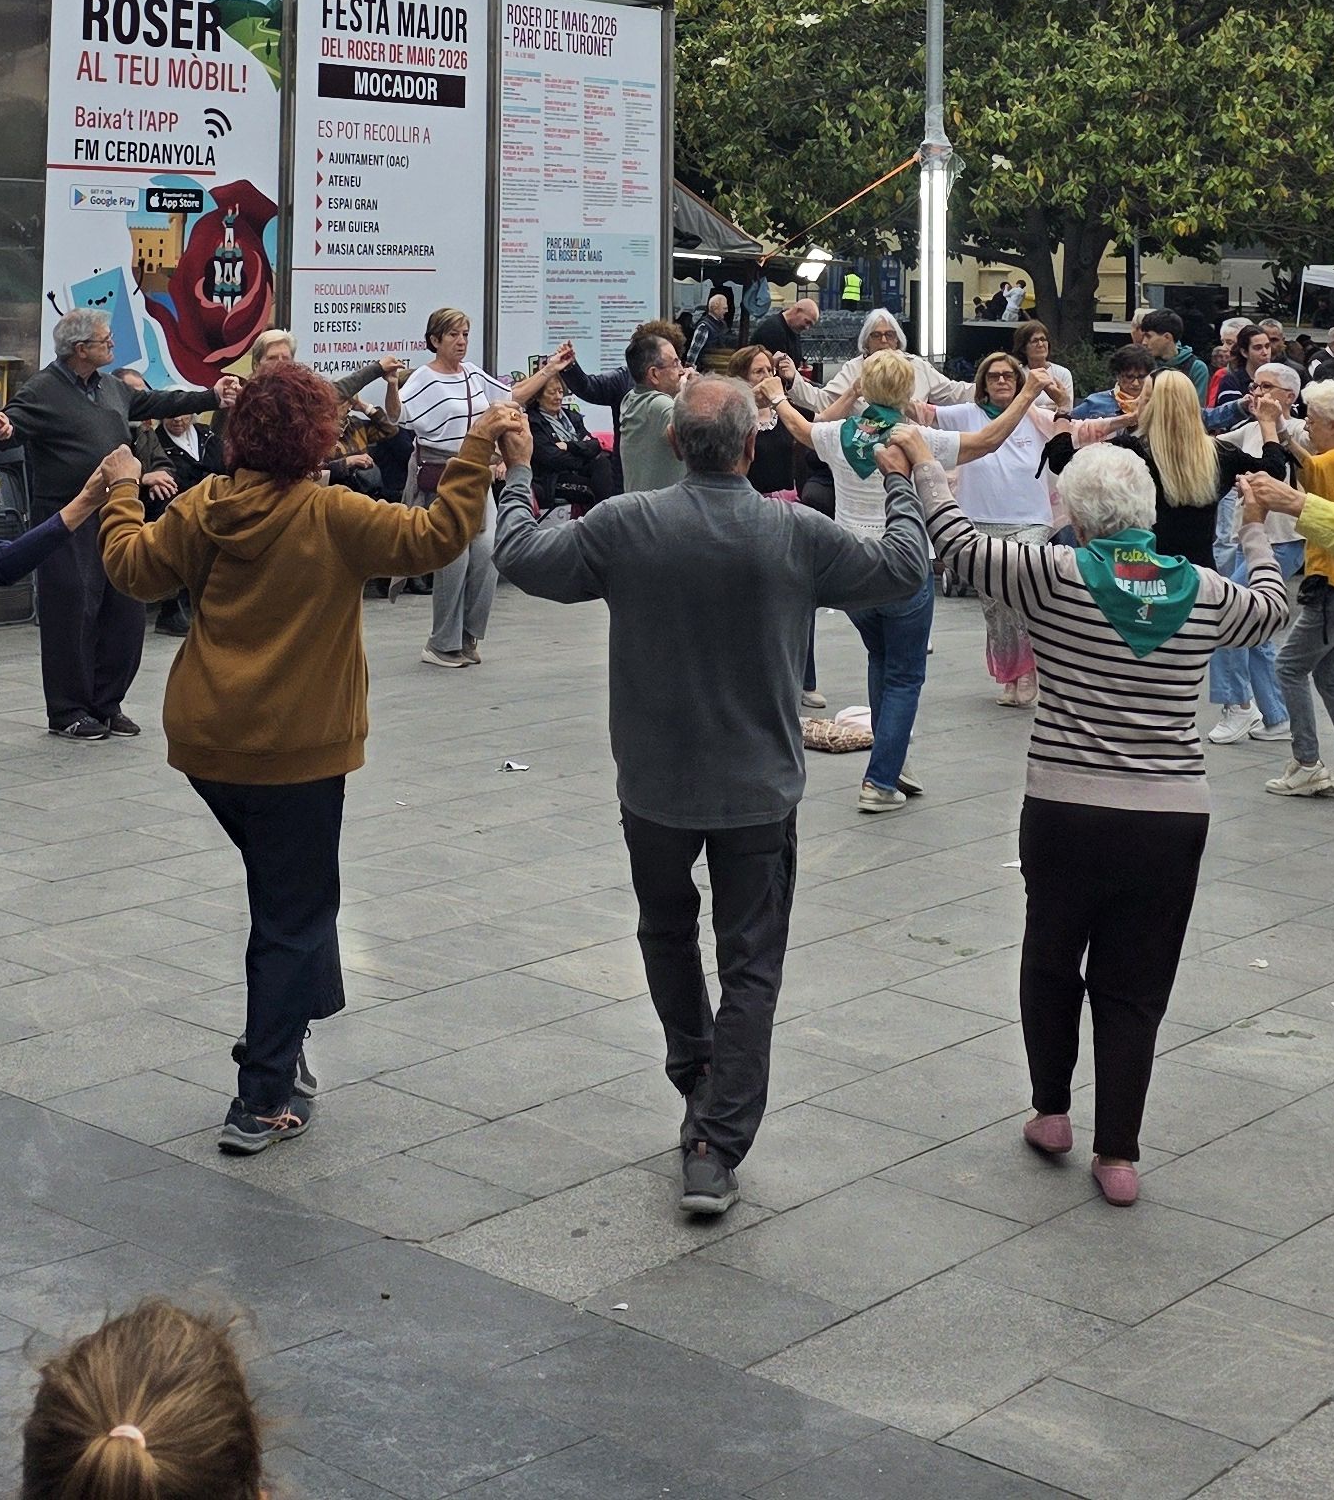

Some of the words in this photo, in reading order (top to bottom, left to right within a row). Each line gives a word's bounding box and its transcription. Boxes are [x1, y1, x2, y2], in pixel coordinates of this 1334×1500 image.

[398, 1, 467, 43] MAJOR
[507, 4, 542, 27] ROSER
[545, 9, 558, 29] DE
[561, 11, 588, 33] MAIG
[591, 15, 617, 37] 2026
[513, 27, 541, 50] PARC
[544, 31, 563, 52] DEL
[566, 33, 613, 57] TURONET
[321, 37, 344, 58] DEL
[347, 39, 385, 62] ROSER
[389, 44, 403, 64] DE
[407, 45, 435, 67] MAIG
[439, 49, 468, 70] 2026
[76, 51, 107, 82] AL
[114, 53, 159, 87] TEU
[168, 52, 247, 93] MÒBIL!
[354, 71, 438, 101] MOCADOR
[318, 120, 333, 138] ES
[337, 121, 360, 140] POT
[364, 123, 420, 143] RECOLLIR
[423, 127, 431, 144] A
[74, 139, 99, 161] FM
[105, 141, 216, 166] CERDANYOLA
[328, 152, 384, 166] AJUNTAMENT
[386, 154, 410, 169] (OAC)
[328, 175, 361, 187] ATENEU
[90, 196, 117, 207] Google
[120, 197, 135, 208] Play
[162, 199, 177, 209] App
[179, 198, 200, 208] Store
[328, 197, 352, 210] ESPAI
[355, 198, 378, 210] GRAN
[328, 220, 346, 232] PEM
[348, 221, 380, 233] GUIERA
[327, 243, 354, 256] MASIA
[357, 243, 374, 256] CAN
[376, 244, 435, 257] SERRAPARERA
[546, 237, 562, 249] PARC
[563, 237, 590, 249] FAMILIAR
[546, 249, 557, 261] DEL
[559, 249, 577, 261] ROSER
[579, 250, 586, 261] DE
[588, 250, 602, 261] MAIG
[314, 283, 357, 296] RECOLLIDA
[359, 284, 389, 296] DURANT
[314, 302, 329, 314] ELS
[332, 302, 348, 313] DOS
[351, 302, 386, 313] PRIMERS
[388, 302, 406, 313] DIES
[313, 321, 324, 332] DE
[327, 320, 362, 332] FESTES:
[313, 342, 326, 353] DIA
[333, 342, 358, 353] TARDA
[366, 341, 378, 352] DIA
[380, 341, 385, 352] 2
[387, 339, 404, 351] MATÍ
[410, 340, 427, 351] TARD
[313, 361, 339, 374] PLAÇA
[1114, 548, 1149, 563] Festes
[1133, 579, 1167, 597] MAIG
